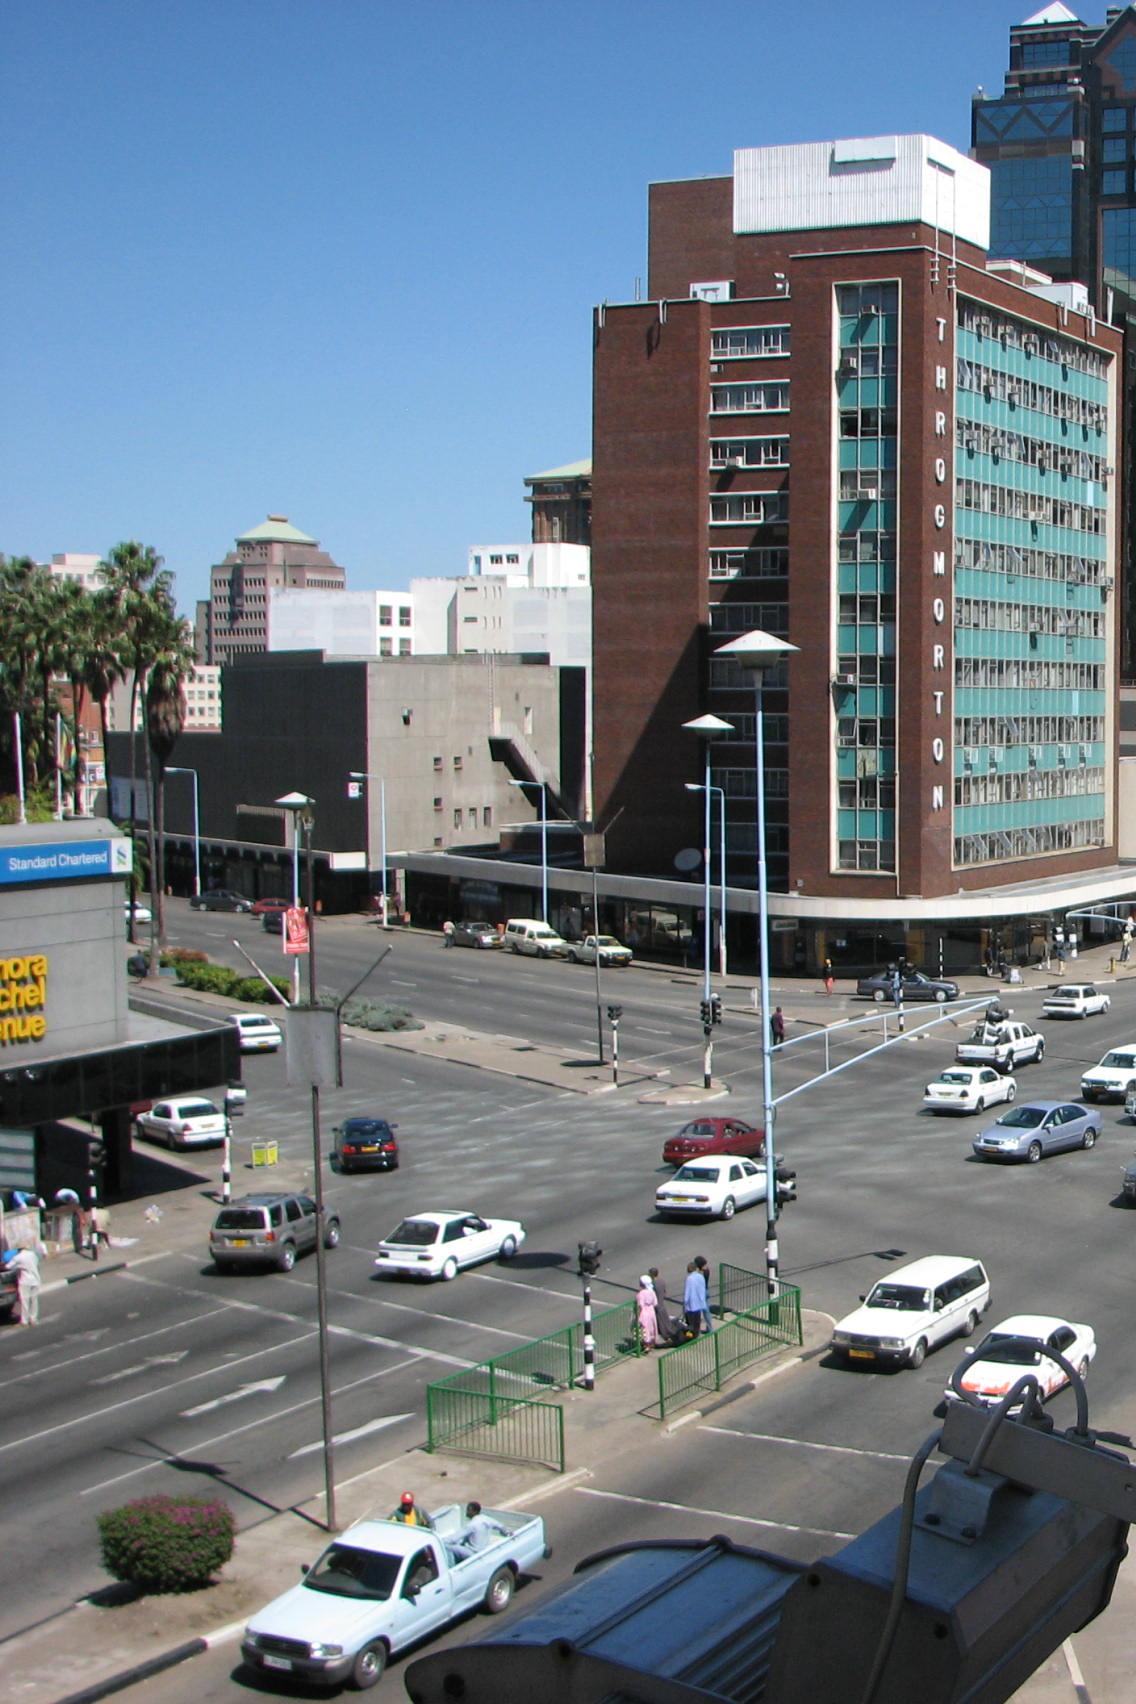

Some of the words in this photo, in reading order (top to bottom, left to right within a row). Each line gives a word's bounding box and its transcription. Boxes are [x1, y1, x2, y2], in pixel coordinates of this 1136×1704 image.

[932, 317, 947, 809] THROGMORTON
[9, 854, 57, 871] Standard
[58, 851, 107, 866] Chartered
[0, 1015, 46, 1040] nue
